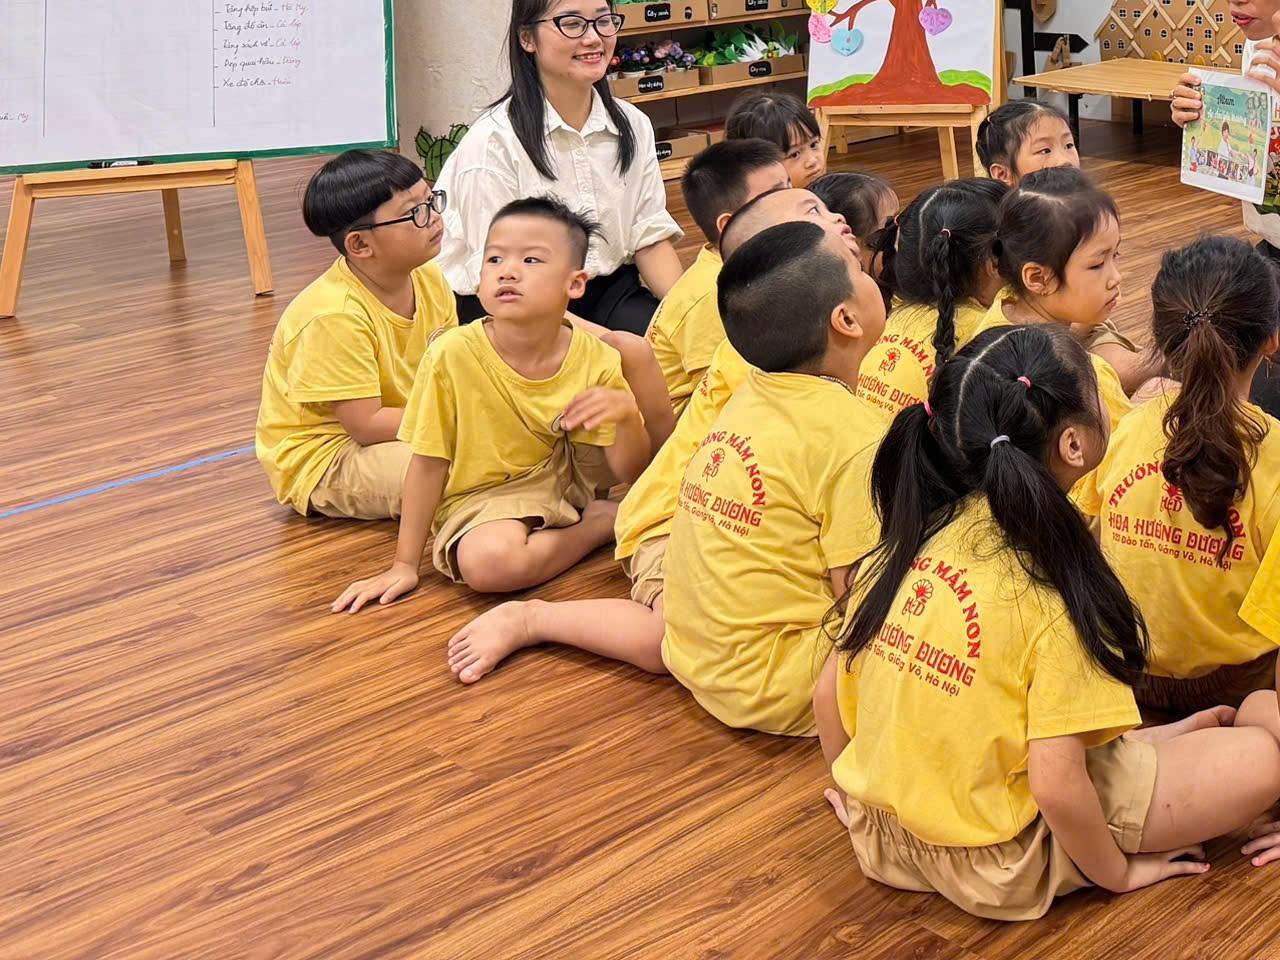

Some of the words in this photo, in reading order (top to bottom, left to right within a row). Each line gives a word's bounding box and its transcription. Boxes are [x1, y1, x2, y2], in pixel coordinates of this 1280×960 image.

[745, 463, 767, 506] NON
[1109, 460, 1165, 508] TRƯỜN
[718, 519, 731, 530] Hà
[733, 524, 750, 537] Nội
[1108, 511, 1129, 533] HOA
[962, 602, 982, 658] NON
[877, 621, 914, 654] ƯỚNG
[915, 641, 976, 687] DƯƠNG
[925, 672, 939, 686] Hà
[941, 681, 961, 697] Nội
